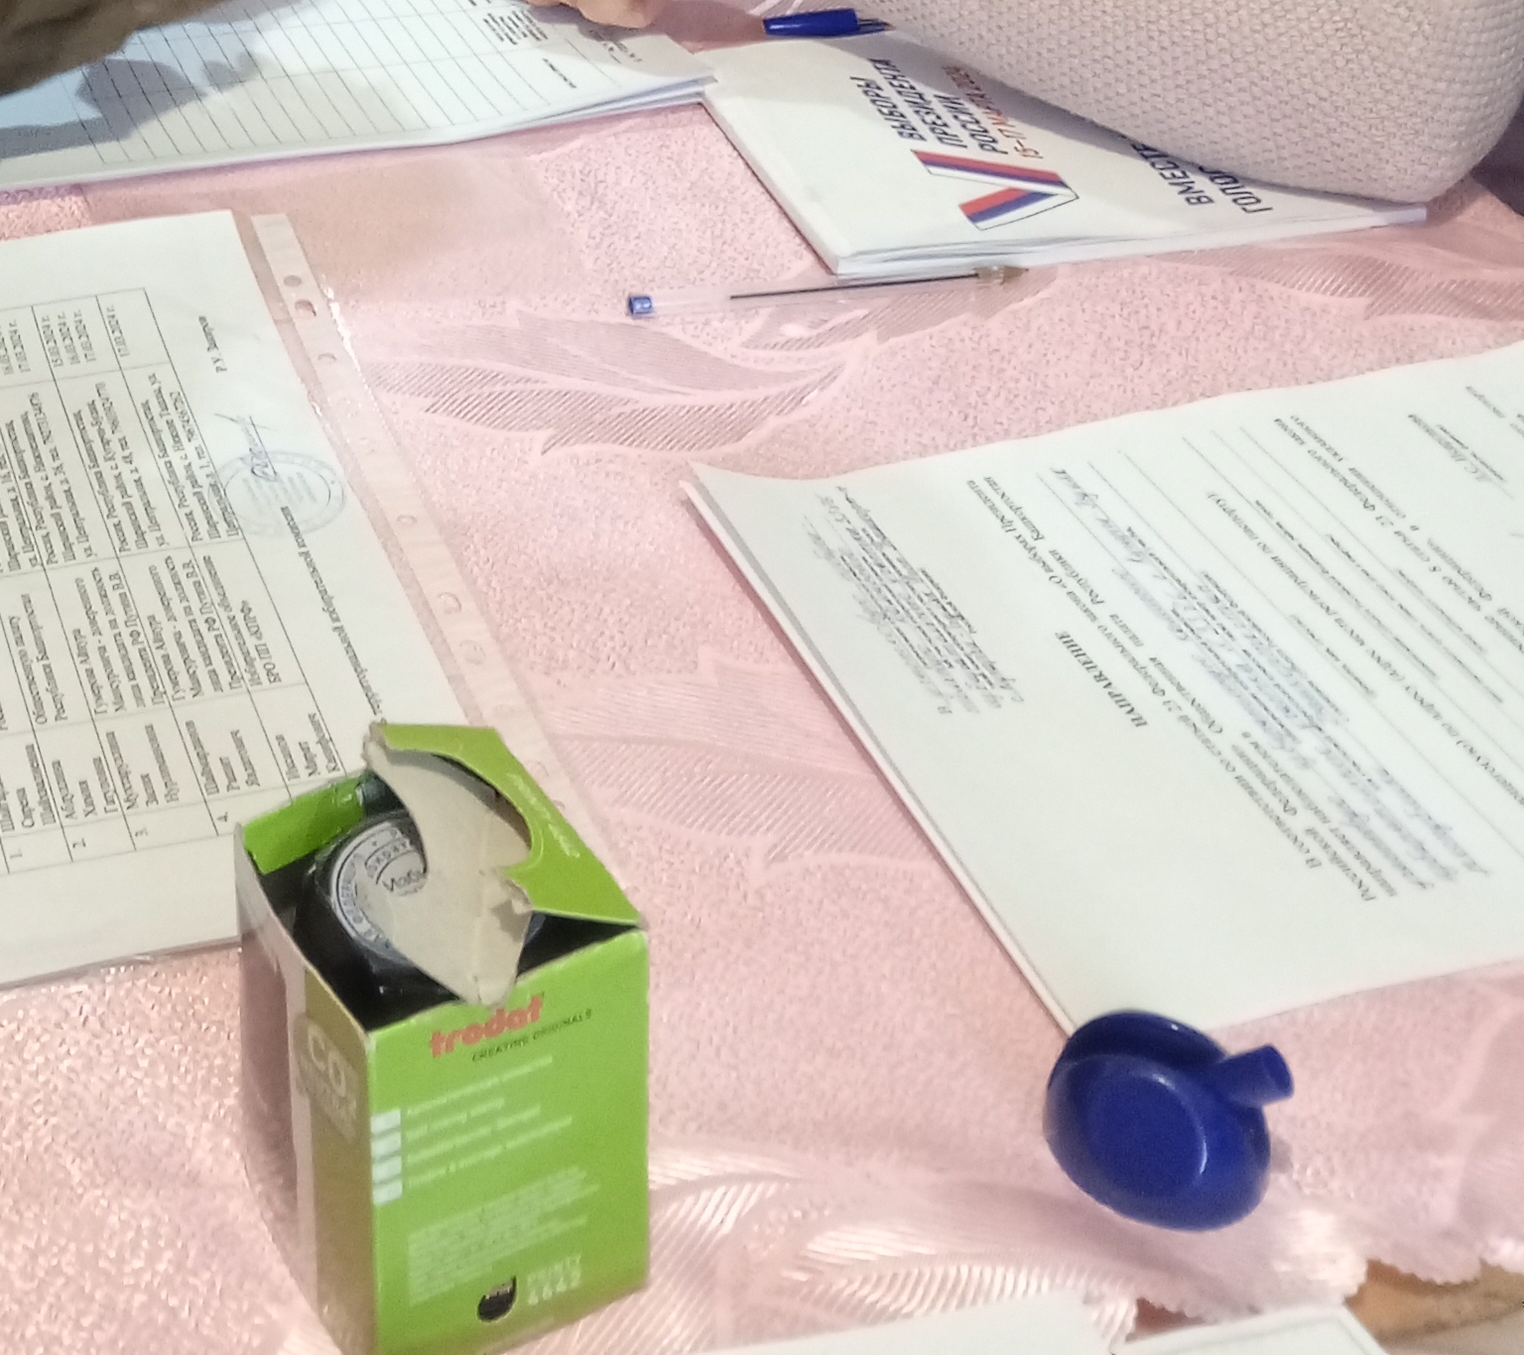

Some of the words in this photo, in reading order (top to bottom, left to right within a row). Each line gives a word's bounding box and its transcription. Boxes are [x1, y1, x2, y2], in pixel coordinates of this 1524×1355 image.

[850, 75, 927, 143] ВЫБОРЫ
[869, 57, 968, 150] ПРЕЗИДЕНТА
[933, 94, 1009, 155] РОССИИ
[279, 505, 307, 549] комиссии
[966, 479, 1017, 533] Президента
[983, 476, 1045, 541] Башкортостан
[297, 549, 341, 623] избирательной
[1013, 533, 1054, 573] выборах
[1048, 549, 1105, 605] Республики
[1065, 590, 1098, 623] закона
[1108, 613, 1144, 647] палата
[331, 624, 382, 716] территориальной
[1054, 631, 1147, 727] НАПРАВЛЕНИЕ
[1096, 624, 1165, 697] Федерального
[1148, 656, 1223, 734] Общественная
[1177, 714, 1222, 757] статьей
[1230, 744, 1297, 816] Федерации»
[1233, 774, 1310, 854] соответствии
[1248, 740, 1331, 824] наблюдателем
[1303, 826, 1376, 901] Российской
[1328, 827, 1397, 897] направляет
[428, 995, 544, 1059] trodat
